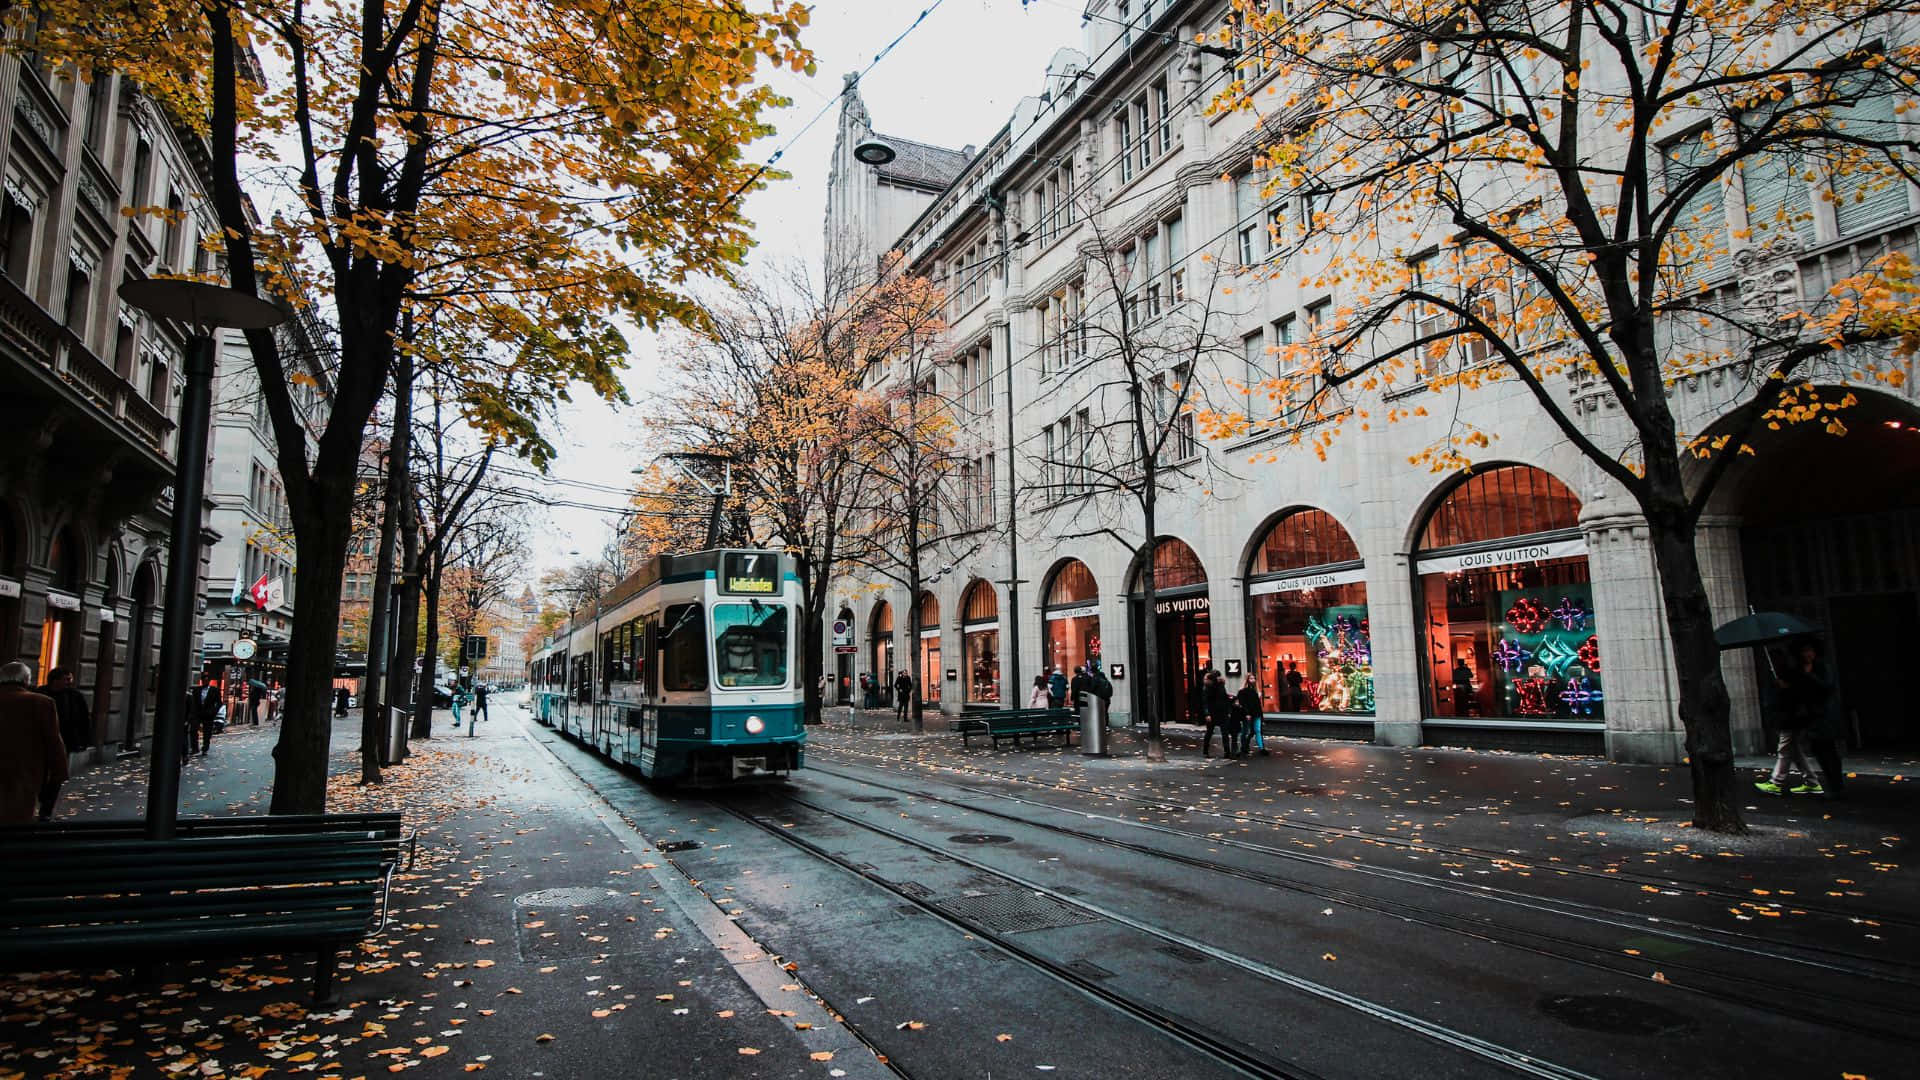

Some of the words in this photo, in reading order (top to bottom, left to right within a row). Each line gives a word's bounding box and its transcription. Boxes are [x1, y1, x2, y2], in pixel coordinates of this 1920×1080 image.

[744, 555, 759, 573] 7
[1459, 554, 1492, 566] LOUIS
[1496, 546, 1549, 561] VUITTON
[1277, 579, 1299, 590] LOUIS
[1302, 575, 1336, 586] VUITTON
